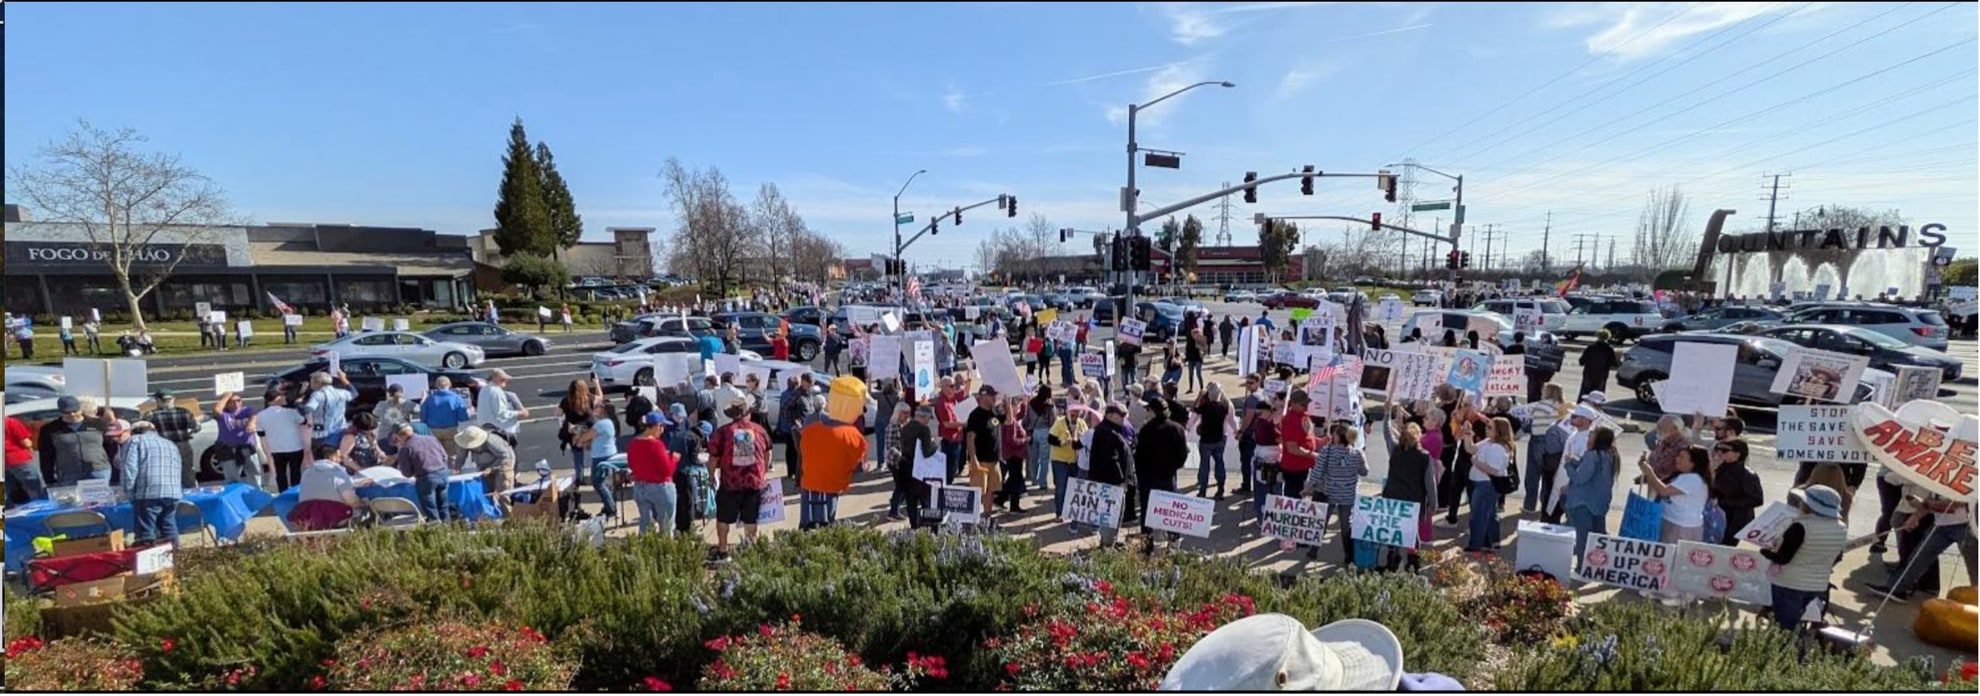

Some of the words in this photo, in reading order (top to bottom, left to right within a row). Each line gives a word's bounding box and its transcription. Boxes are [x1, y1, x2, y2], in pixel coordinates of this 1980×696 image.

[28, 247, 89, 260] FOGO
[92, 250, 113, 260] DE
[1365, 350, 1394, 364] NO
[1810, 407, 1848, 418] STOP
[1780, 421, 1805, 432] THE
[1809, 421, 1847, 432] SAVE
[1807, 435, 1846, 446] SAVE
[1915, 426, 1979, 466] BE
[1777, 449, 1835, 460] WOMENS
[1863, 419, 1979, 496] AWARE
[1073, 479, 1113, 498] ICE
[1171, 500, 1189, 510] NO
[1274, 496, 1317, 516] MAGA
[1358, 495, 1414, 519] SAVE
[1162, 517, 1193, 530] CUTS!
[1264, 510, 1325, 530] MURDERS
[1369, 513, 1402, 529] THE
[1262, 522, 1321, 543] AMERICA
[1362, 526, 1404, 545] ACA
[1595, 536, 1667, 559] STAND
[1613, 556, 1641, 570] UP
